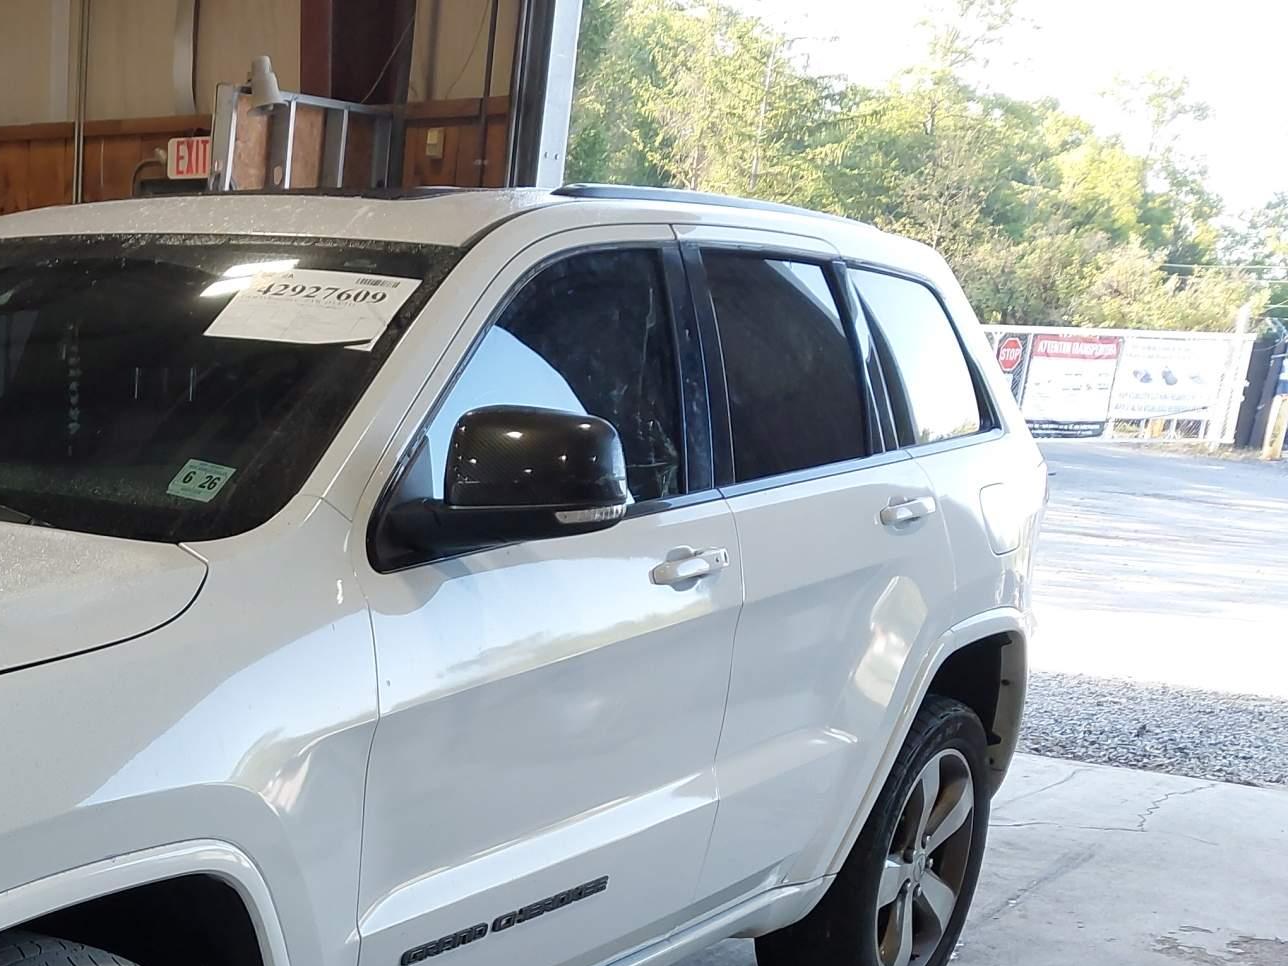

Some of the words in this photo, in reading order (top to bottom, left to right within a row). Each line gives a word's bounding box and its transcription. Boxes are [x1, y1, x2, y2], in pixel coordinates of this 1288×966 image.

[175, 139, 210, 176] EXIT
[256, 282, 388, 304] 42927609
[999, 347, 1021, 361] STOP
[182, 470, 197, 484] 6
[198, 474, 221, 491] 26
[400, 921, 489, 966] GRAND
[490, 874, 609, 933] CHEROKEE
